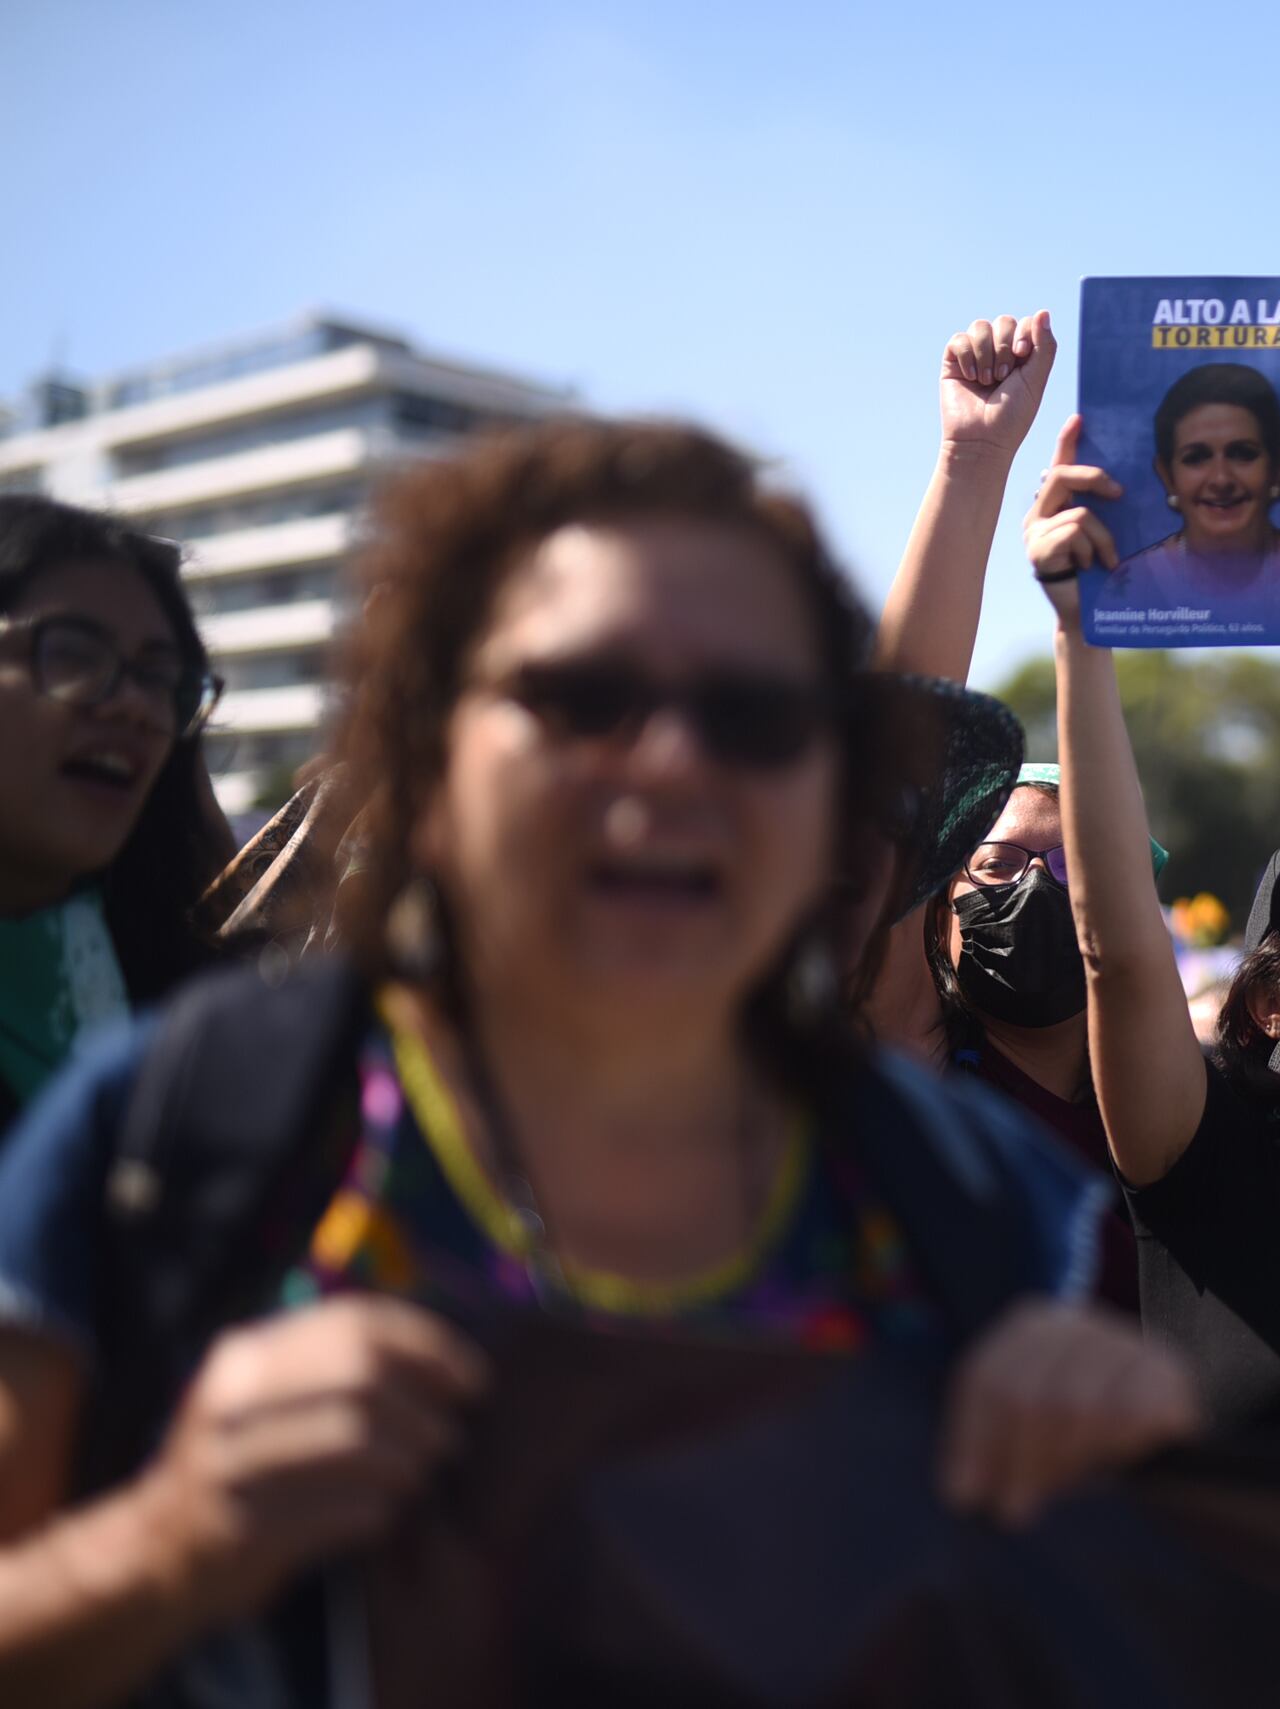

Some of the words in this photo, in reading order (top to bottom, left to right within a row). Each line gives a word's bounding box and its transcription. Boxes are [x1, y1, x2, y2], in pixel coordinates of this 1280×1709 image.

[1152, 298, 1225, 324] ALTO
[1229, 299, 1251, 324] A
[1094, 607, 1145, 622] Jeannine
[1148, 606, 1211, 621] Horvilleur
